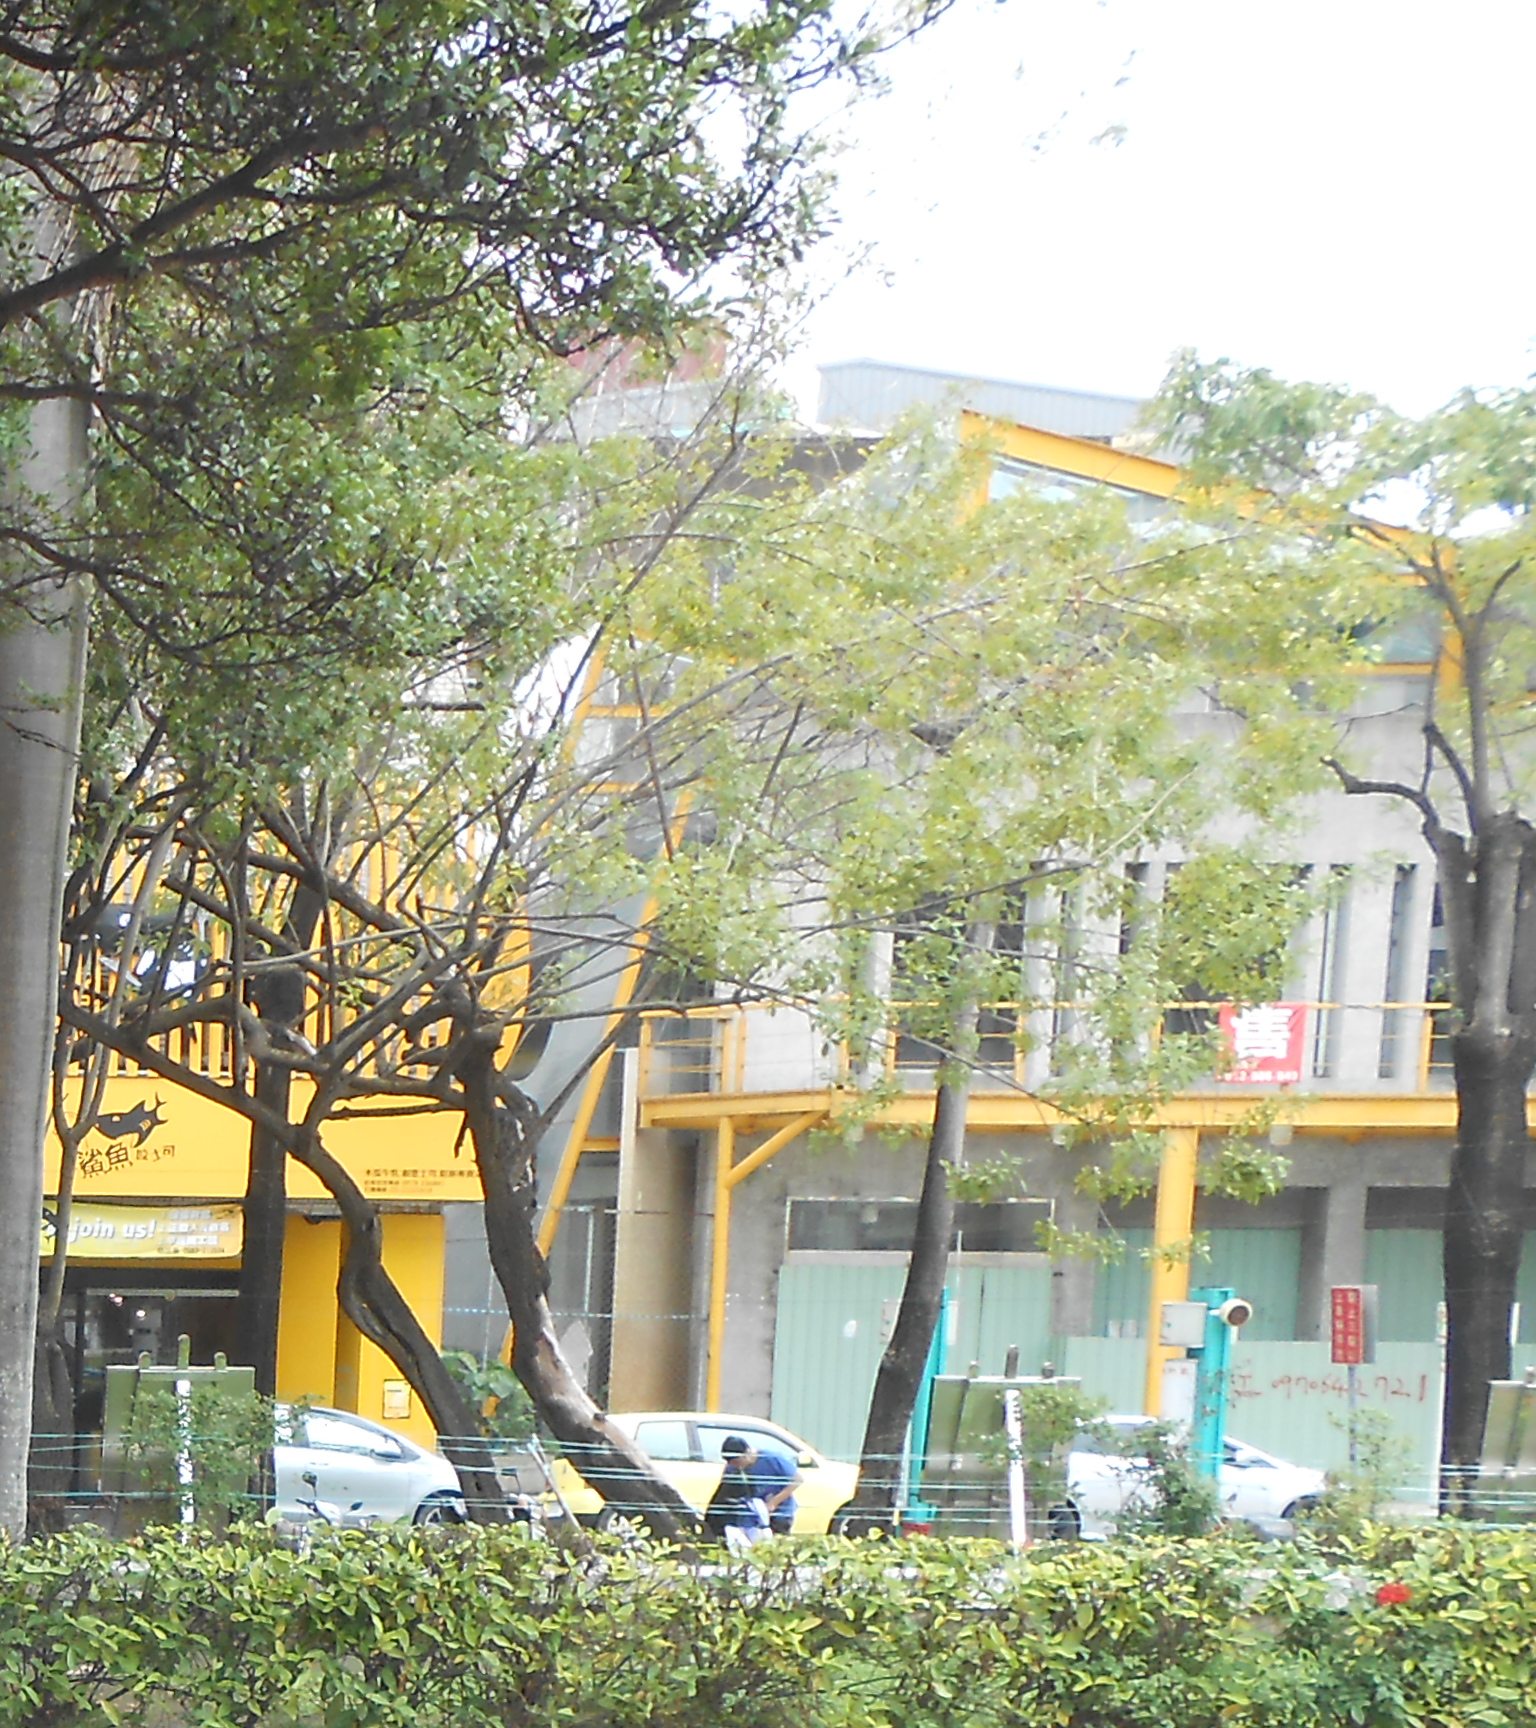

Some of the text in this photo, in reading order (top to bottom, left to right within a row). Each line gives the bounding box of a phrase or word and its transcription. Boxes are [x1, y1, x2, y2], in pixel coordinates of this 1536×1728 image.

[1230, 1003, 1293, 1059] 售
[67, 1218, 158, 1243] join us!
